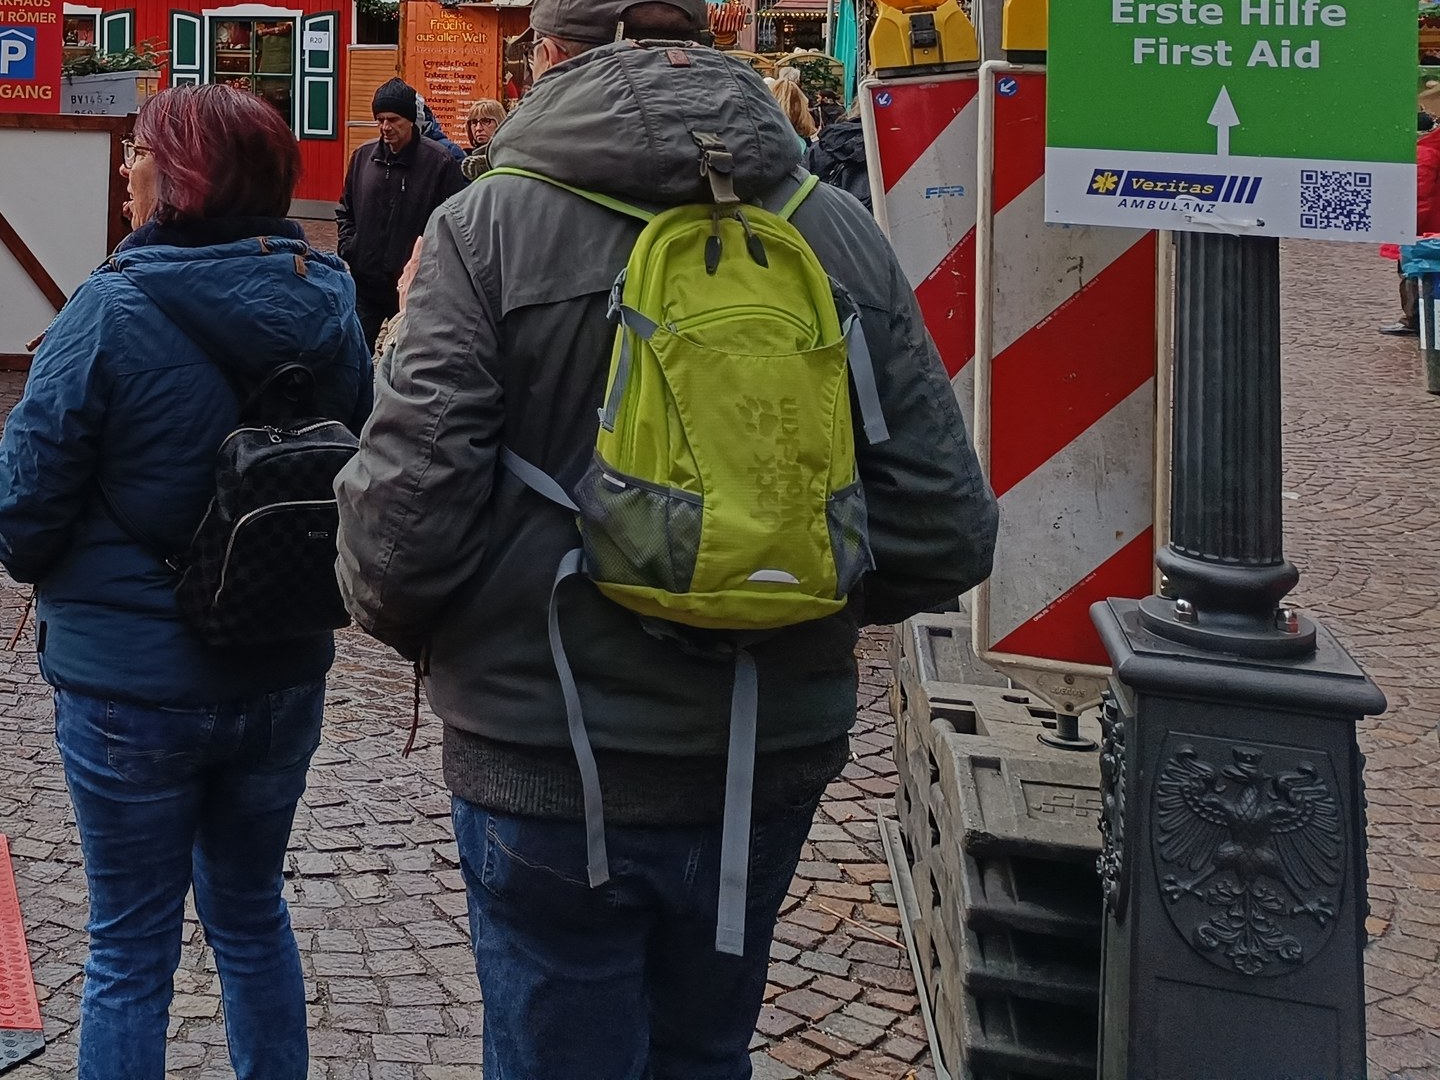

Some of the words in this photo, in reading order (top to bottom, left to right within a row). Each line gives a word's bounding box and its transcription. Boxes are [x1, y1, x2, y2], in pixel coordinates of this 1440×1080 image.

[7, 8, 57, 24] RÖMER
[429, 19, 473, 32] Früchte
[416, 34, 435, 43] aus
[437, 32, 460, 43] aller
[462, 32, 488, 44] Welt
[0, 39, 27, 74] P
[1133, 37, 1233, 67] First
[1246, 39, 1321, 69] Aid
[1131, 176, 1215, 195] Veritas
[747, 452, 780, 532] Jack
